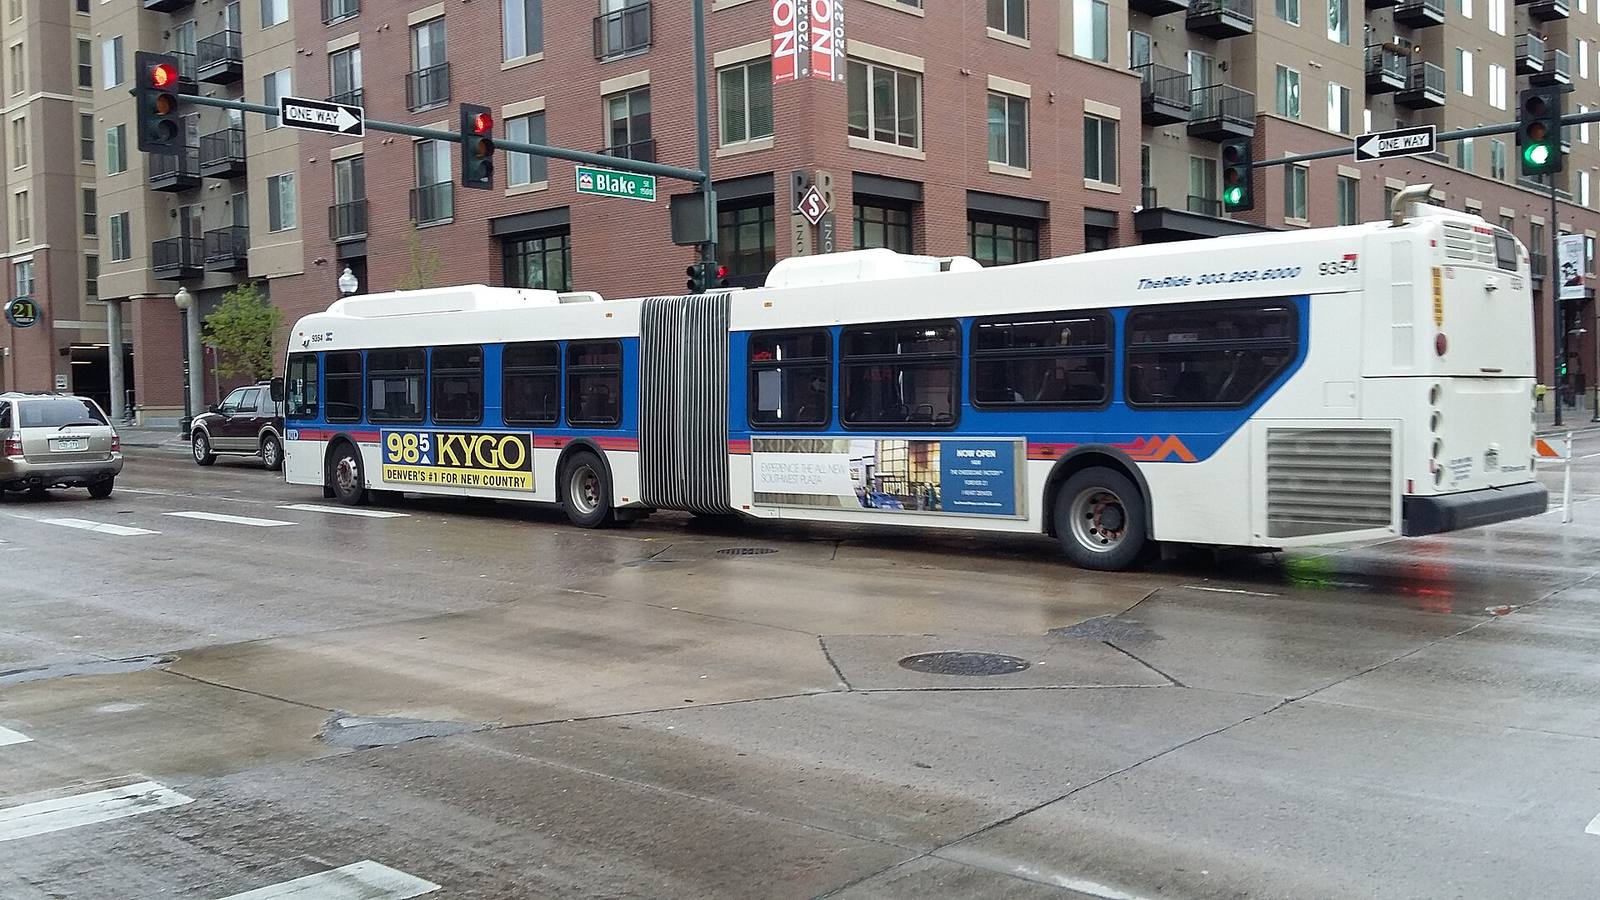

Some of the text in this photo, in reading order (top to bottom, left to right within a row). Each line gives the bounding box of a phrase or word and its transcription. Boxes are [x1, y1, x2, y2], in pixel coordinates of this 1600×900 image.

[289, 107, 339, 124] ONE WAY
[1378, 135, 1426, 151] ONE WAY
[596, 174, 636, 194] Blake
[808, 193, 820, 217] S
[1318, 260, 1358, 276] 9354
[1137, 266, 1302, 290] TheRide 303.299.6000
[13, 303, 35, 317] 21
[436, 433, 526, 470] KYGO
[956, 449, 997, 458] NOW OPEN
[387, 469, 526, 488] DENVER'S #1 FOR NEW COUNTRY
